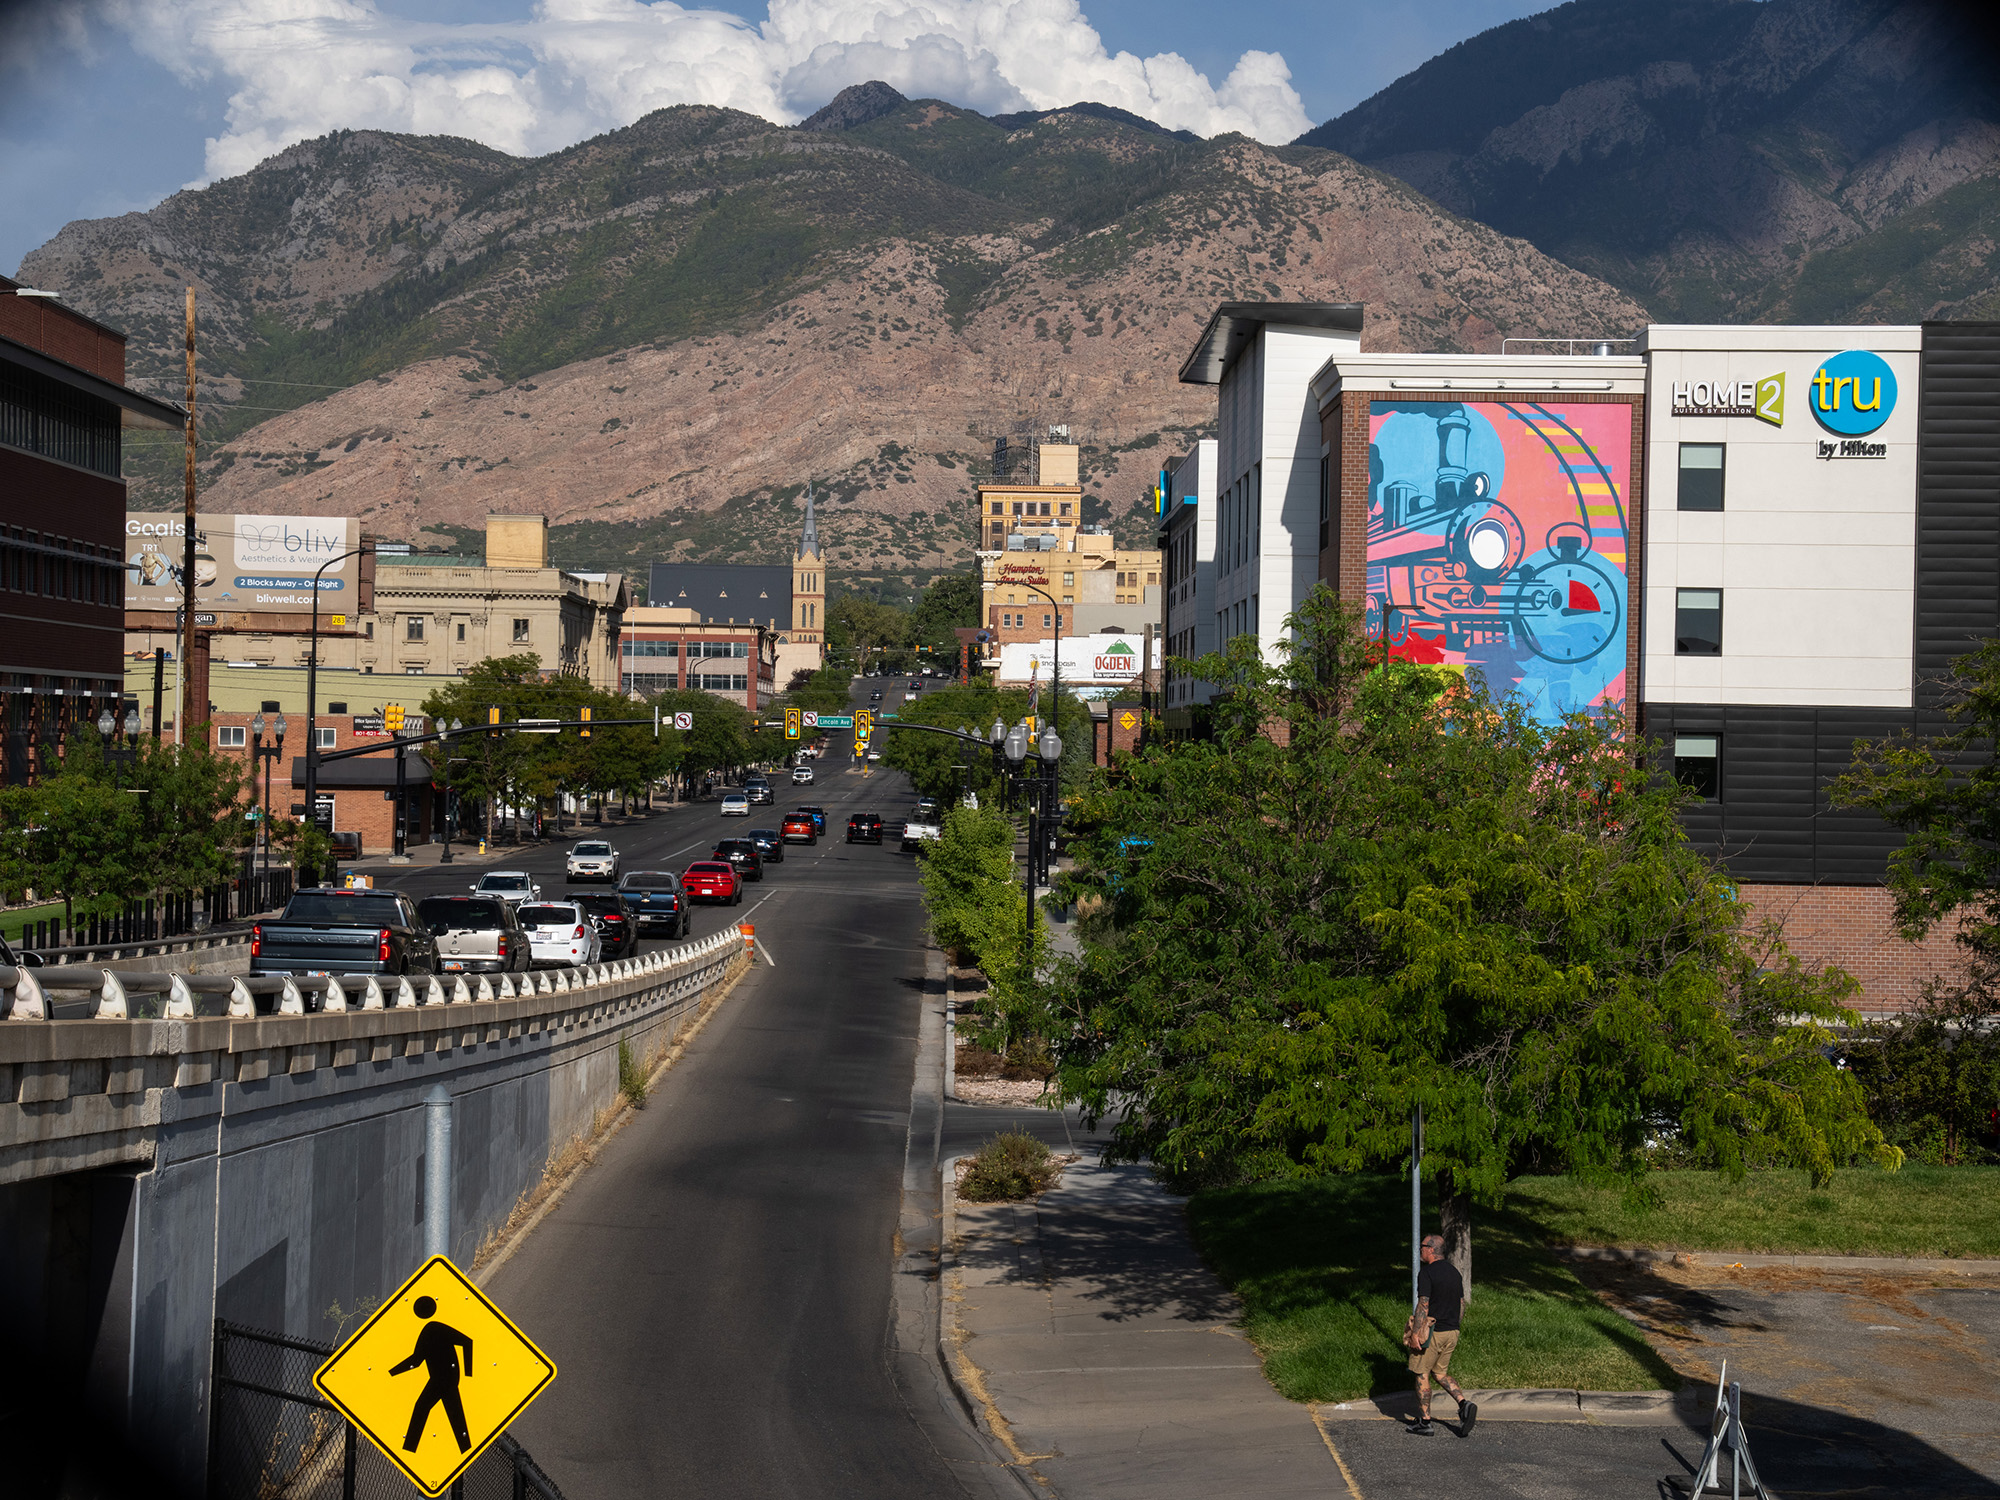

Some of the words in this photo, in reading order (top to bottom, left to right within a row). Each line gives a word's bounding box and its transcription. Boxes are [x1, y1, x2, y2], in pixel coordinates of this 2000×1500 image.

[1813, 368, 1881, 411] tru
[1818, 440, 1838, 461] by
[1840, 440, 1887, 456] Hilton
[284, 524, 338, 553] bliv
[142, 543, 158, 552] TRT
[240, 554, 287, 563] Aesthetics
[289, 555, 296, 563] &
[998, 562, 1045, 575] Hampton
[240, 578, 246, 586] 2
[247, 578, 274, 587] Blocks
[275, 579, 297, 588] Away
[317, 580, 338, 589] Right
[1025, 575, 1049, 586] Suites
[256, 594, 320, 604] blivwell.com
[332, 616, 345, 624] 283
[1095, 655, 1131, 671] OGDEN
[430, 1480, 438, 1488] 21
